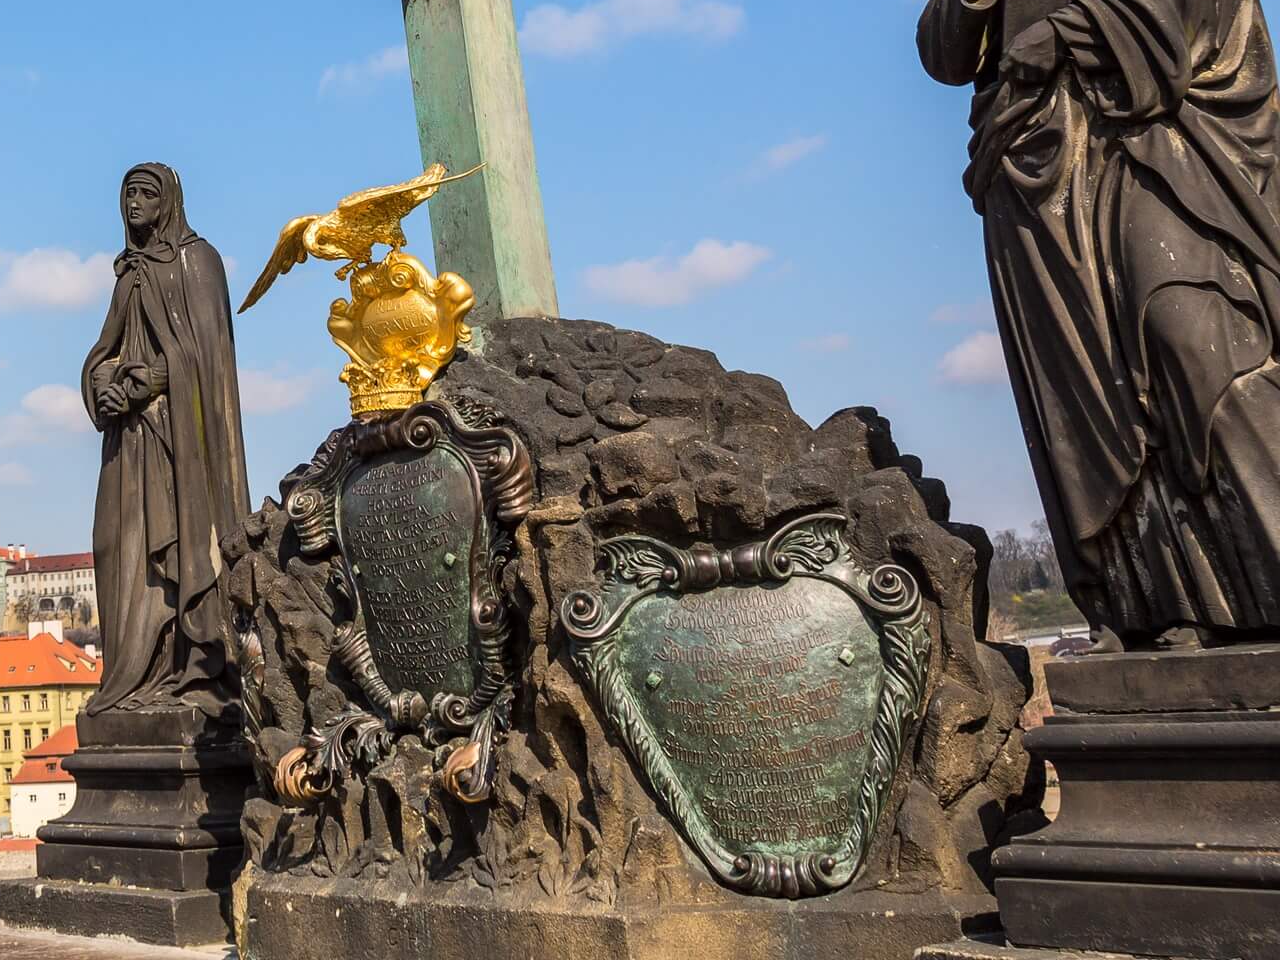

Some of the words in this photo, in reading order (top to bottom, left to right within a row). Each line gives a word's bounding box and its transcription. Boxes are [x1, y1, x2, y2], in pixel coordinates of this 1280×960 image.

[368, 494, 415, 512] HONORI
[403, 511, 458, 538] CRVCEM
[407, 616, 455, 637] DOMINI
